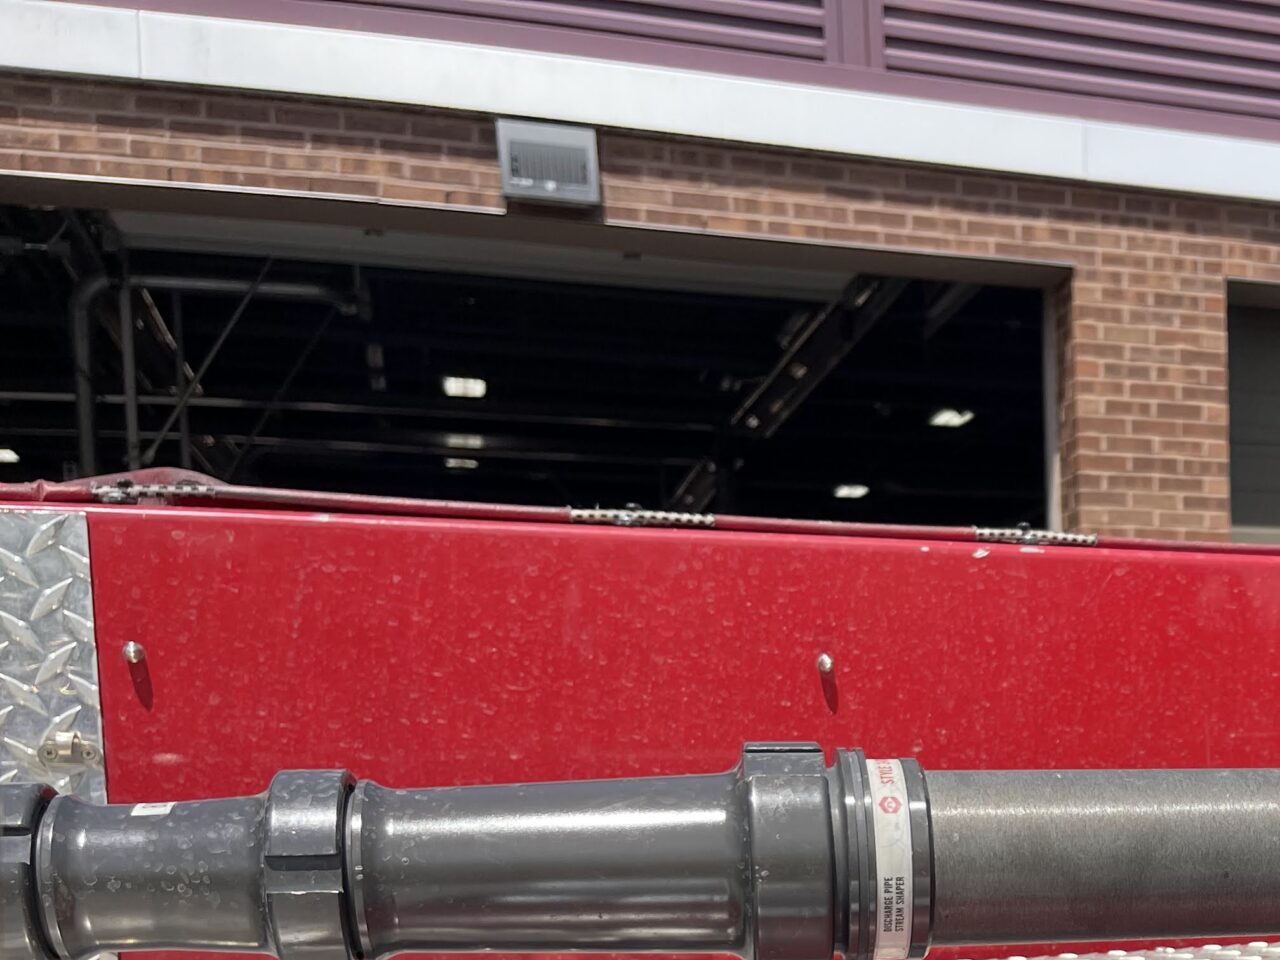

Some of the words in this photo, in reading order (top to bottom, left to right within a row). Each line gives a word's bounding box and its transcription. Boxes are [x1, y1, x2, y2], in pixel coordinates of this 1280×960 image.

[884, 877, 893, 892] PIPE
[895, 877, 905, 905] SHAPER
[884, 892, 893, 932] DISCHARGE
[895, 908, 904, 932] STREAM
